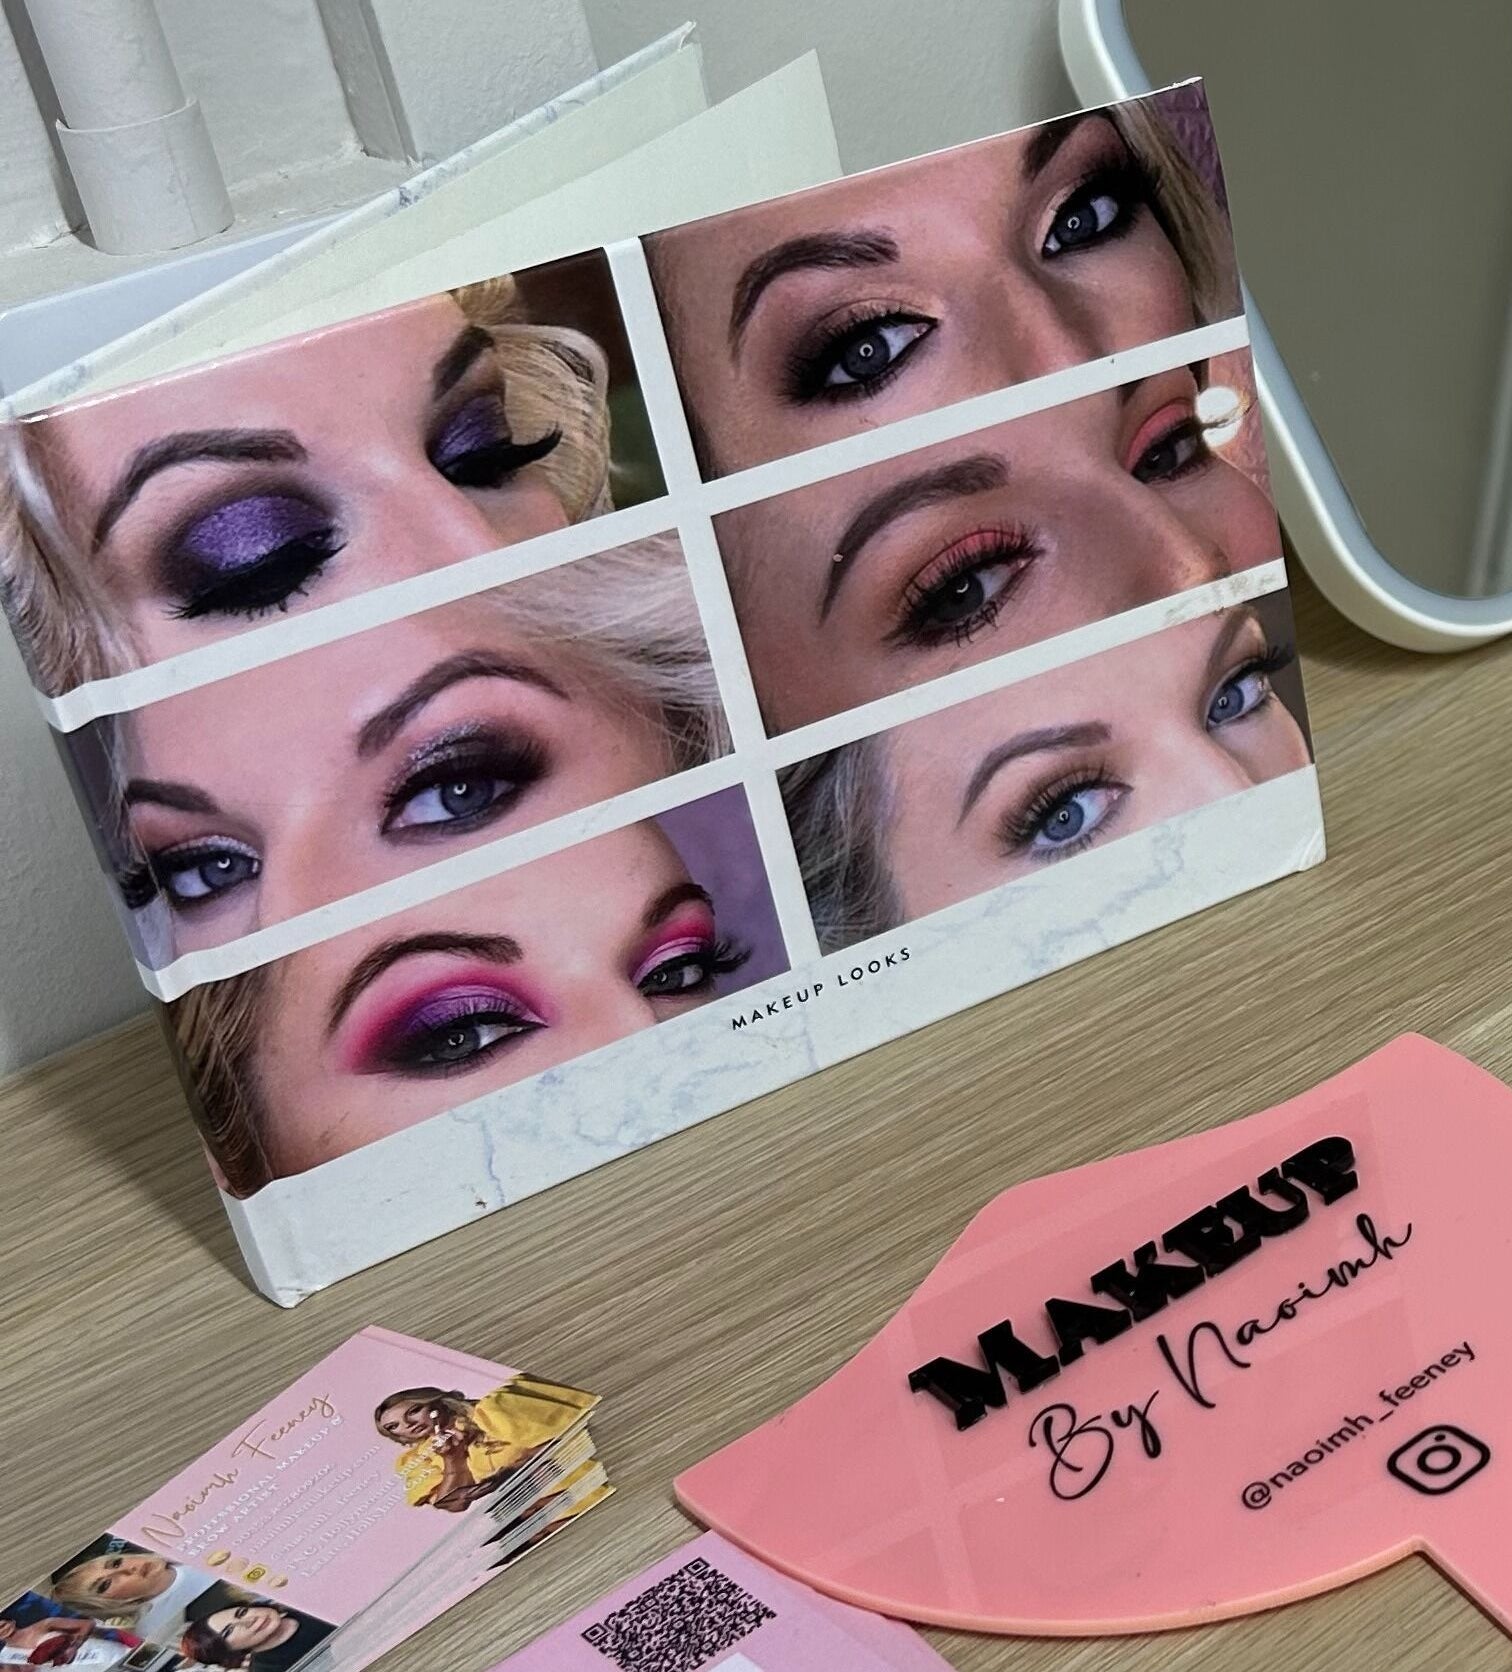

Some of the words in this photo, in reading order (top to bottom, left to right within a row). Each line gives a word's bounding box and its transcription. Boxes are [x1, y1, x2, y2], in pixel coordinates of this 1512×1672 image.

[732, 983, 824, 1030] MAKEUP
[838, 947, 911, 987] LOOKS
[907, 1135, 1359, 1432] MAKEUP
[1029, 1389, 1161, 1501] By
[1156, 1213, 1413, 1410] Naoimh
[140, 1467, 240, 1549] Naoimh
[231, 1393, 335, 1460] Feeney
[176, 1474, 277, 1553] PROFESSIONAL
[275, 1426, 330, 1472] MAKEUP
[1241, 1341, 1476, 1510] @naoimh_feeney
[187, 1523, 230, 1558] BROW
[233, 1483, 281, 1524] ARTIST
